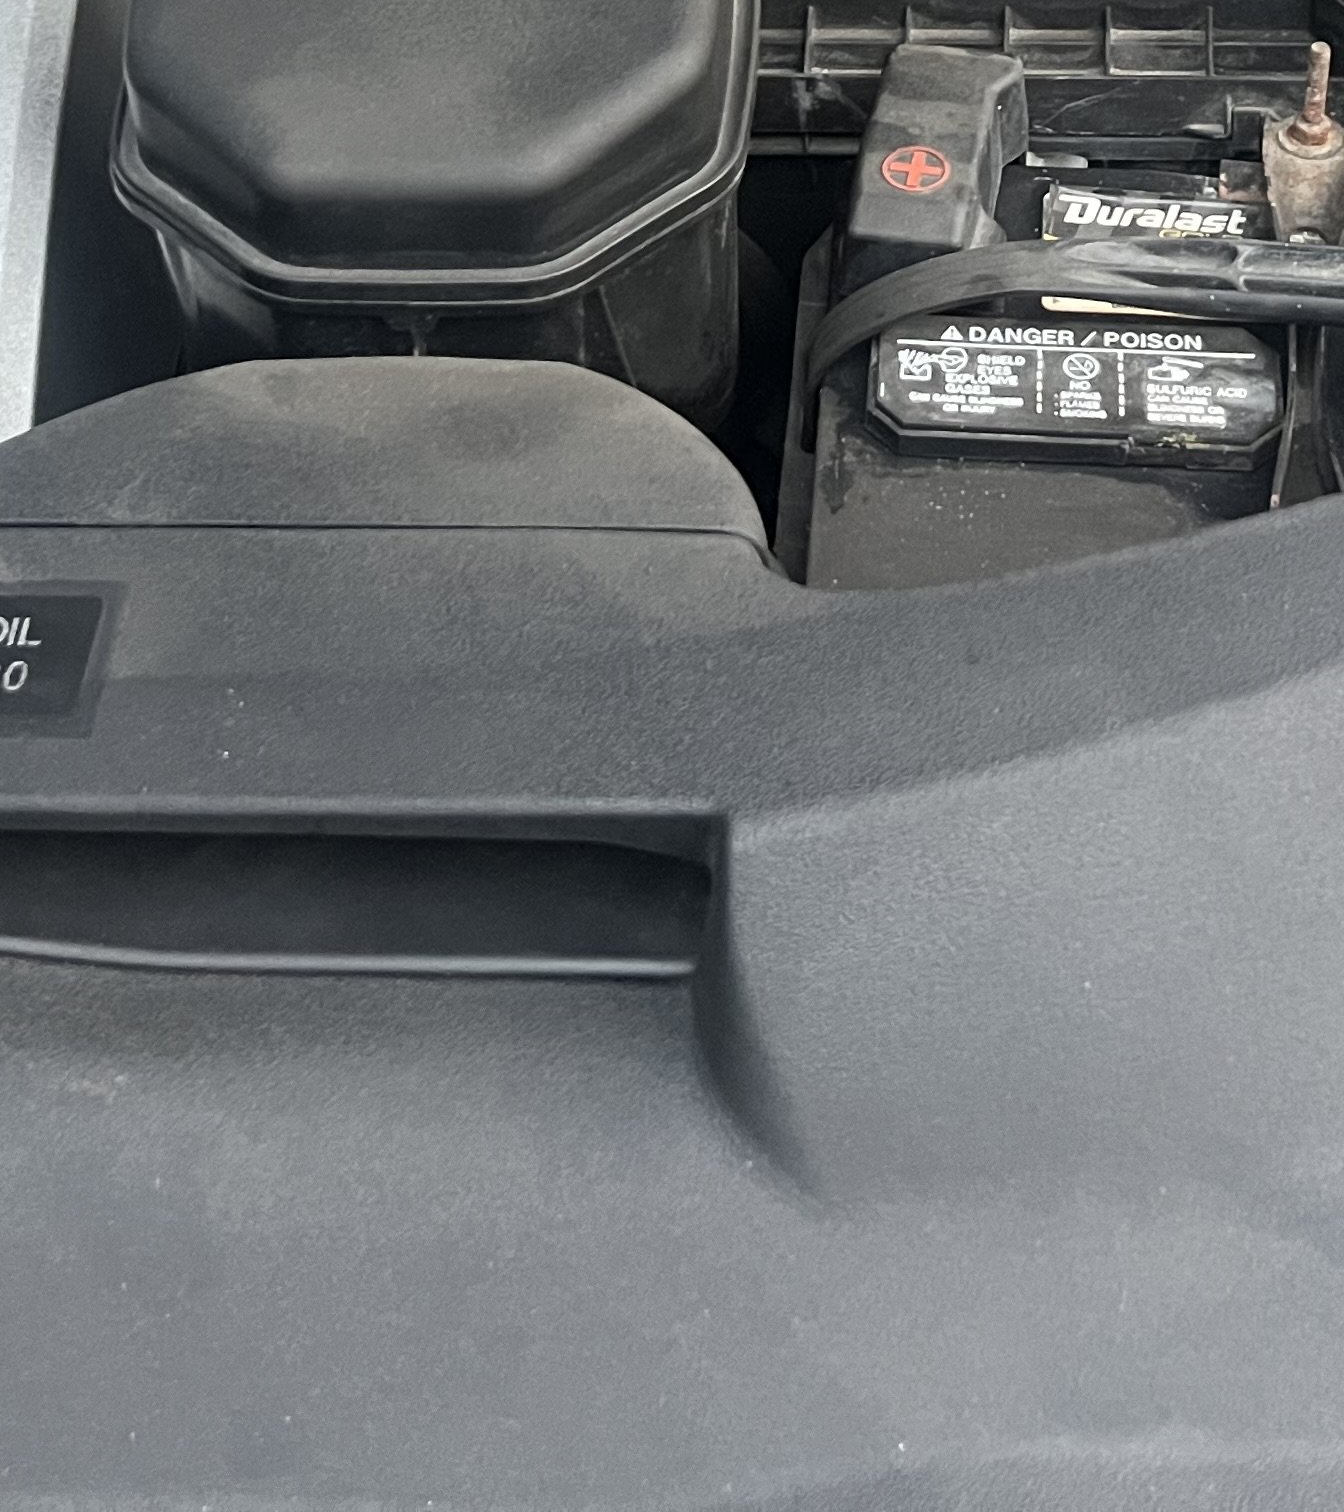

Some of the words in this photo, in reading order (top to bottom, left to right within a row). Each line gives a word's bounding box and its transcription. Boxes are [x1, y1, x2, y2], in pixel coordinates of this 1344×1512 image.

[1057, 193, 1247, 235] Duralast
[968, 326, 1075, 346] DANGER
[1103, 331, 1202, 351] POISON
[976, 353, 1026, 366] SHIELD
[976, 365, 1012, 376] EYES
[944, 372, 1019, 386] EXPLOSIVE
[1069, 380, 1091, 391] NO
[944, 383, 991, 395] GASES
[1146, 383, 1212, 396] SULFURIC
[1216, 386, 1248, 399] ACID
